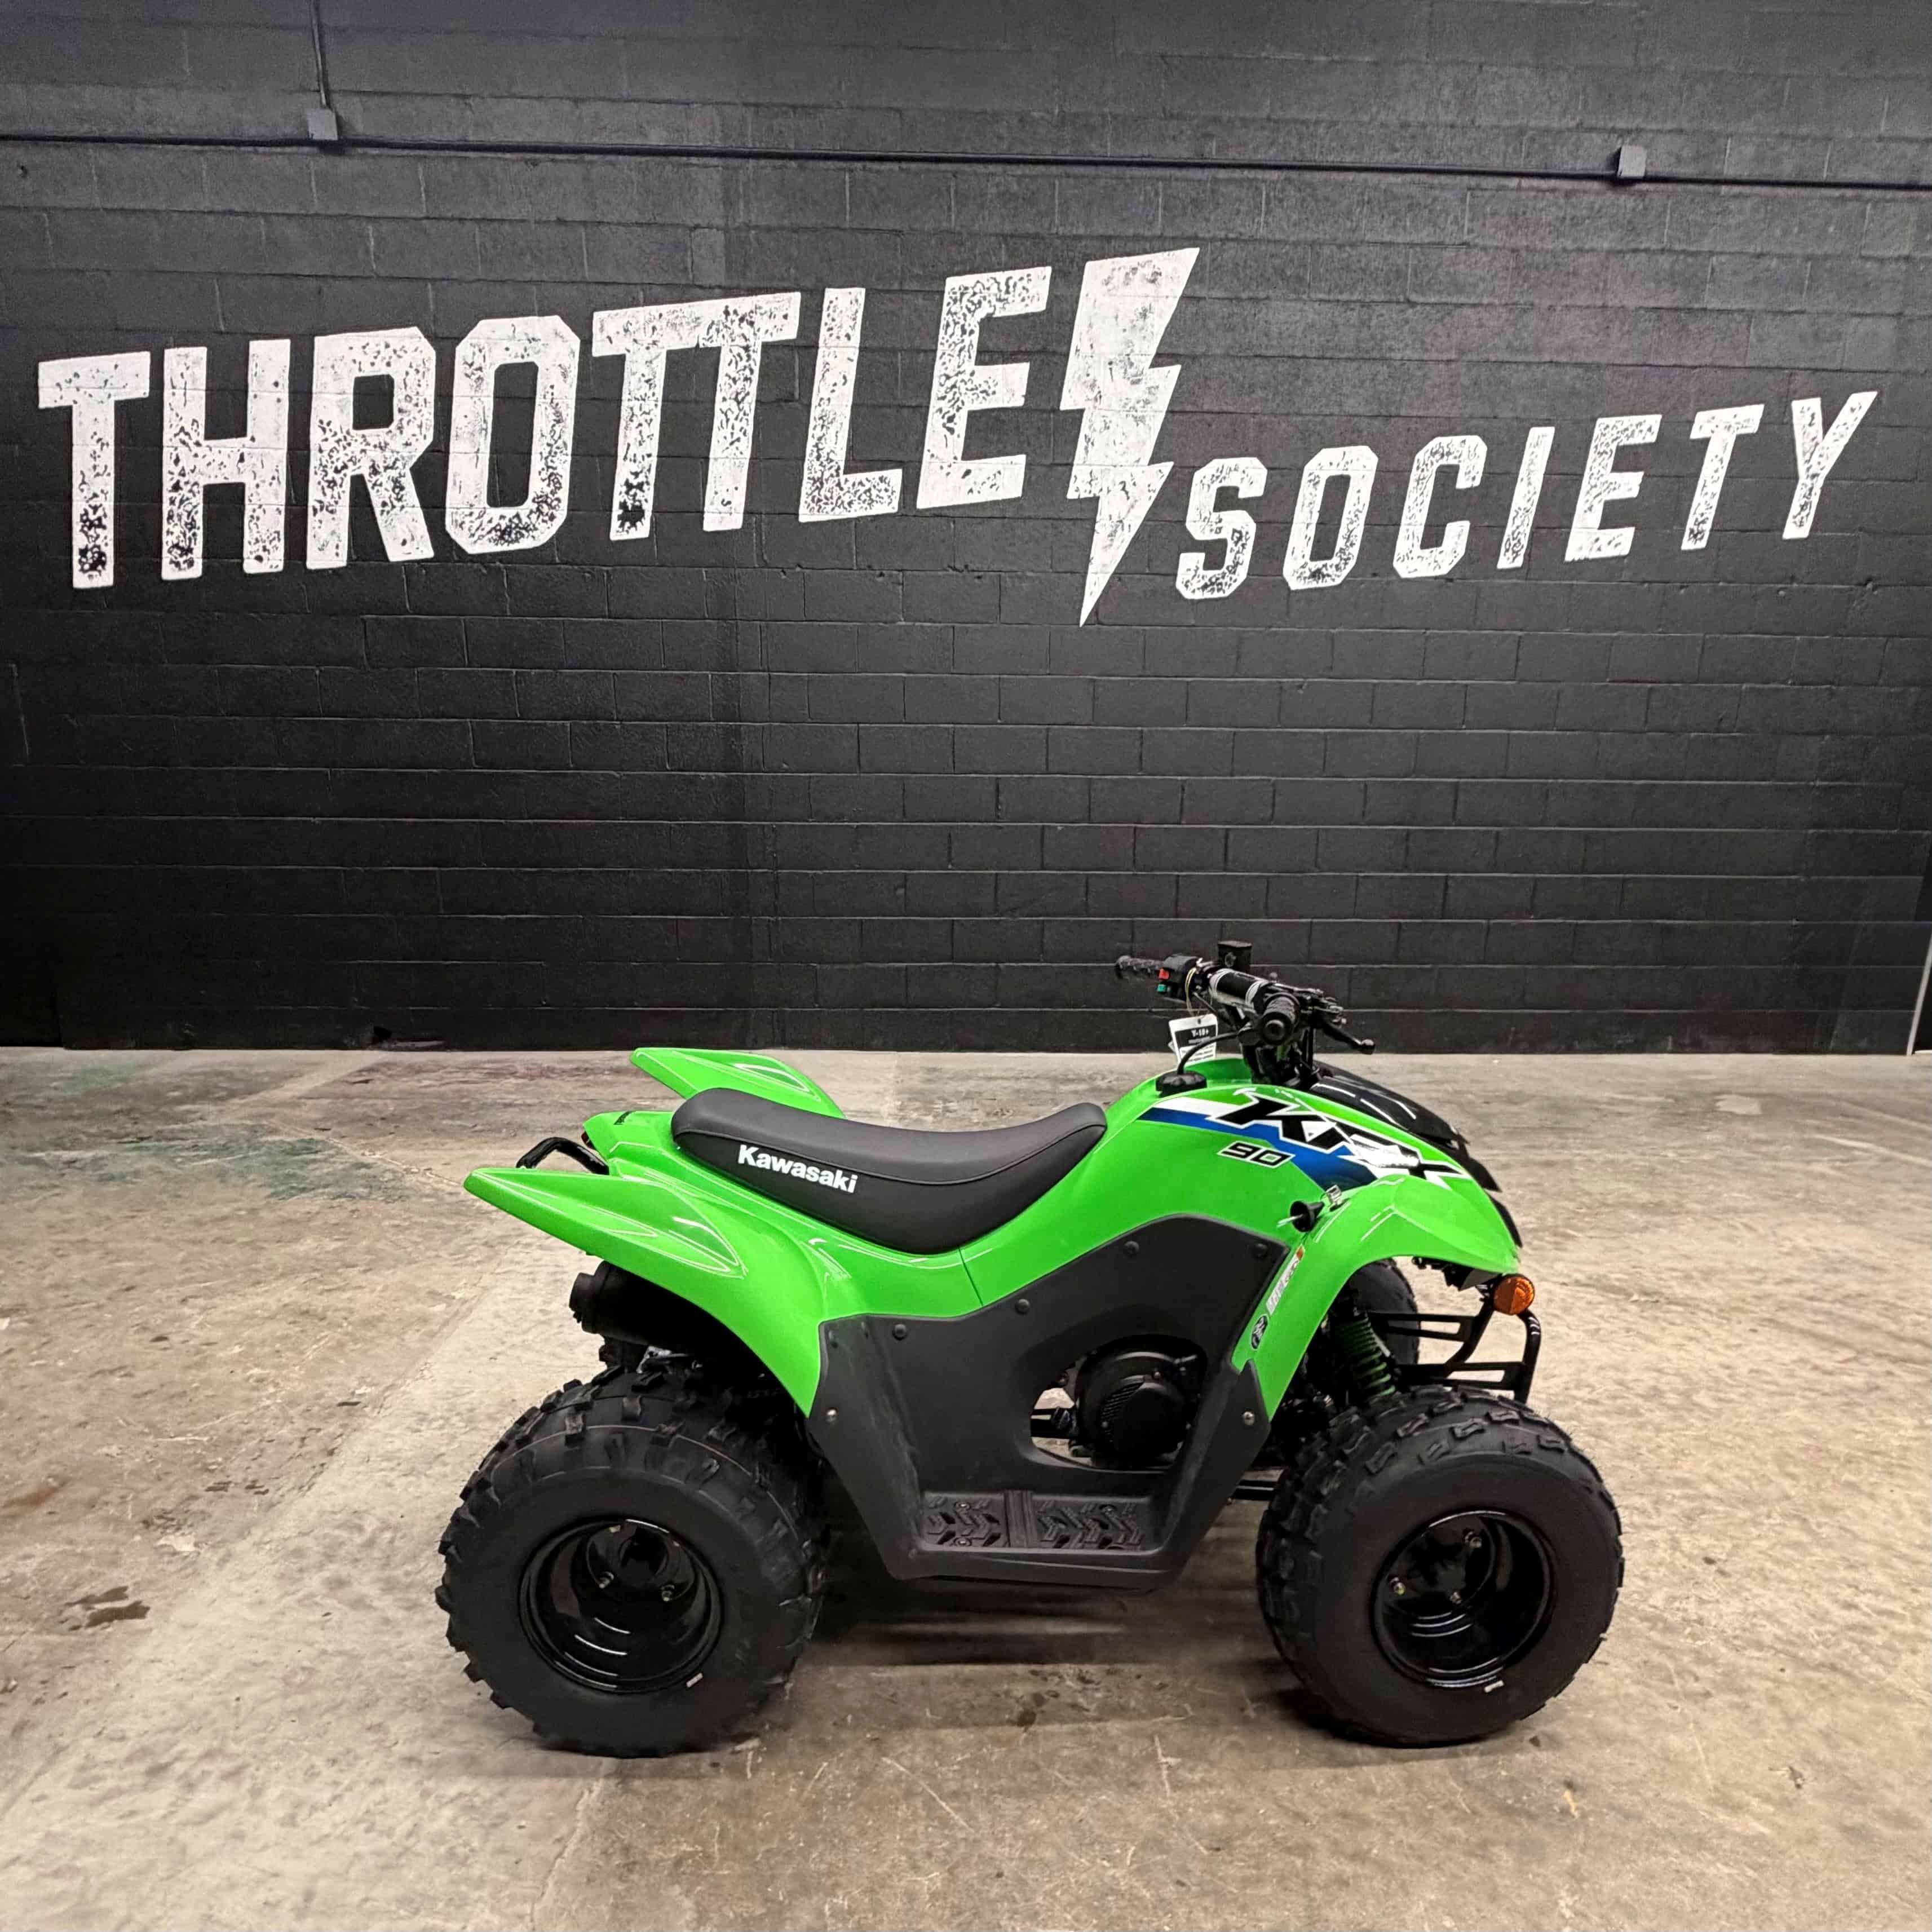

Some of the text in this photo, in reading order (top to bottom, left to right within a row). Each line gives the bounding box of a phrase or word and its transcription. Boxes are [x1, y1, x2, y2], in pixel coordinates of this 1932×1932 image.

[38, 265, 1877, 600] THROTTLE SOCIETY
[737, 1144, 858, 1193] Kawasaki
[1222, 1142, 1288, 1167] 90
